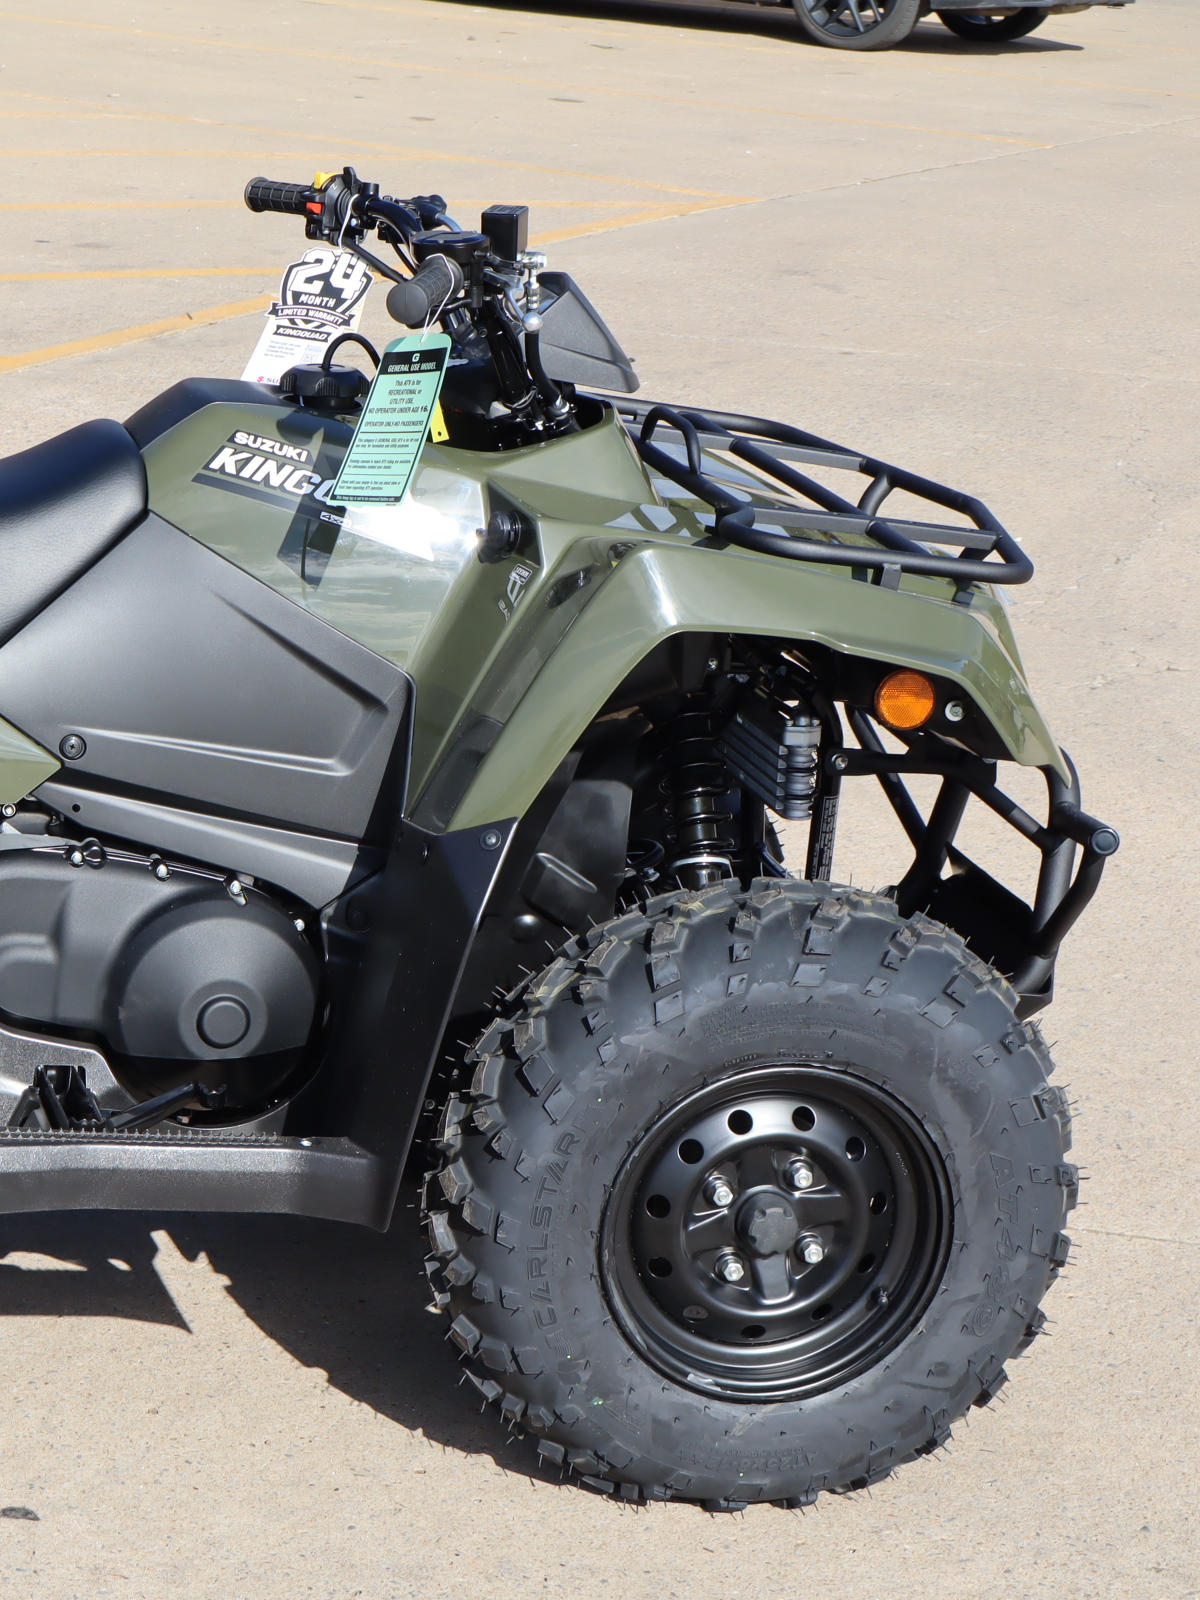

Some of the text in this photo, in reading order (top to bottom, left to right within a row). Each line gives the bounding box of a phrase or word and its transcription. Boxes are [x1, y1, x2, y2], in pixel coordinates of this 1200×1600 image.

[288, 248, 368, 300] 24
[299, 294, 336, 308] MONTH
[278, 308, 343, 325] LIMITED WARRANTY
[277, 327, 328, 340] KINGQUAD
[412, 353, 420, 362] G
[388, 362, 437, 372] GENERAL USE MODEL
[234, 432, 308, 462] SUZUKI
[526, 1127, 582, 1331] CARLSTAR
